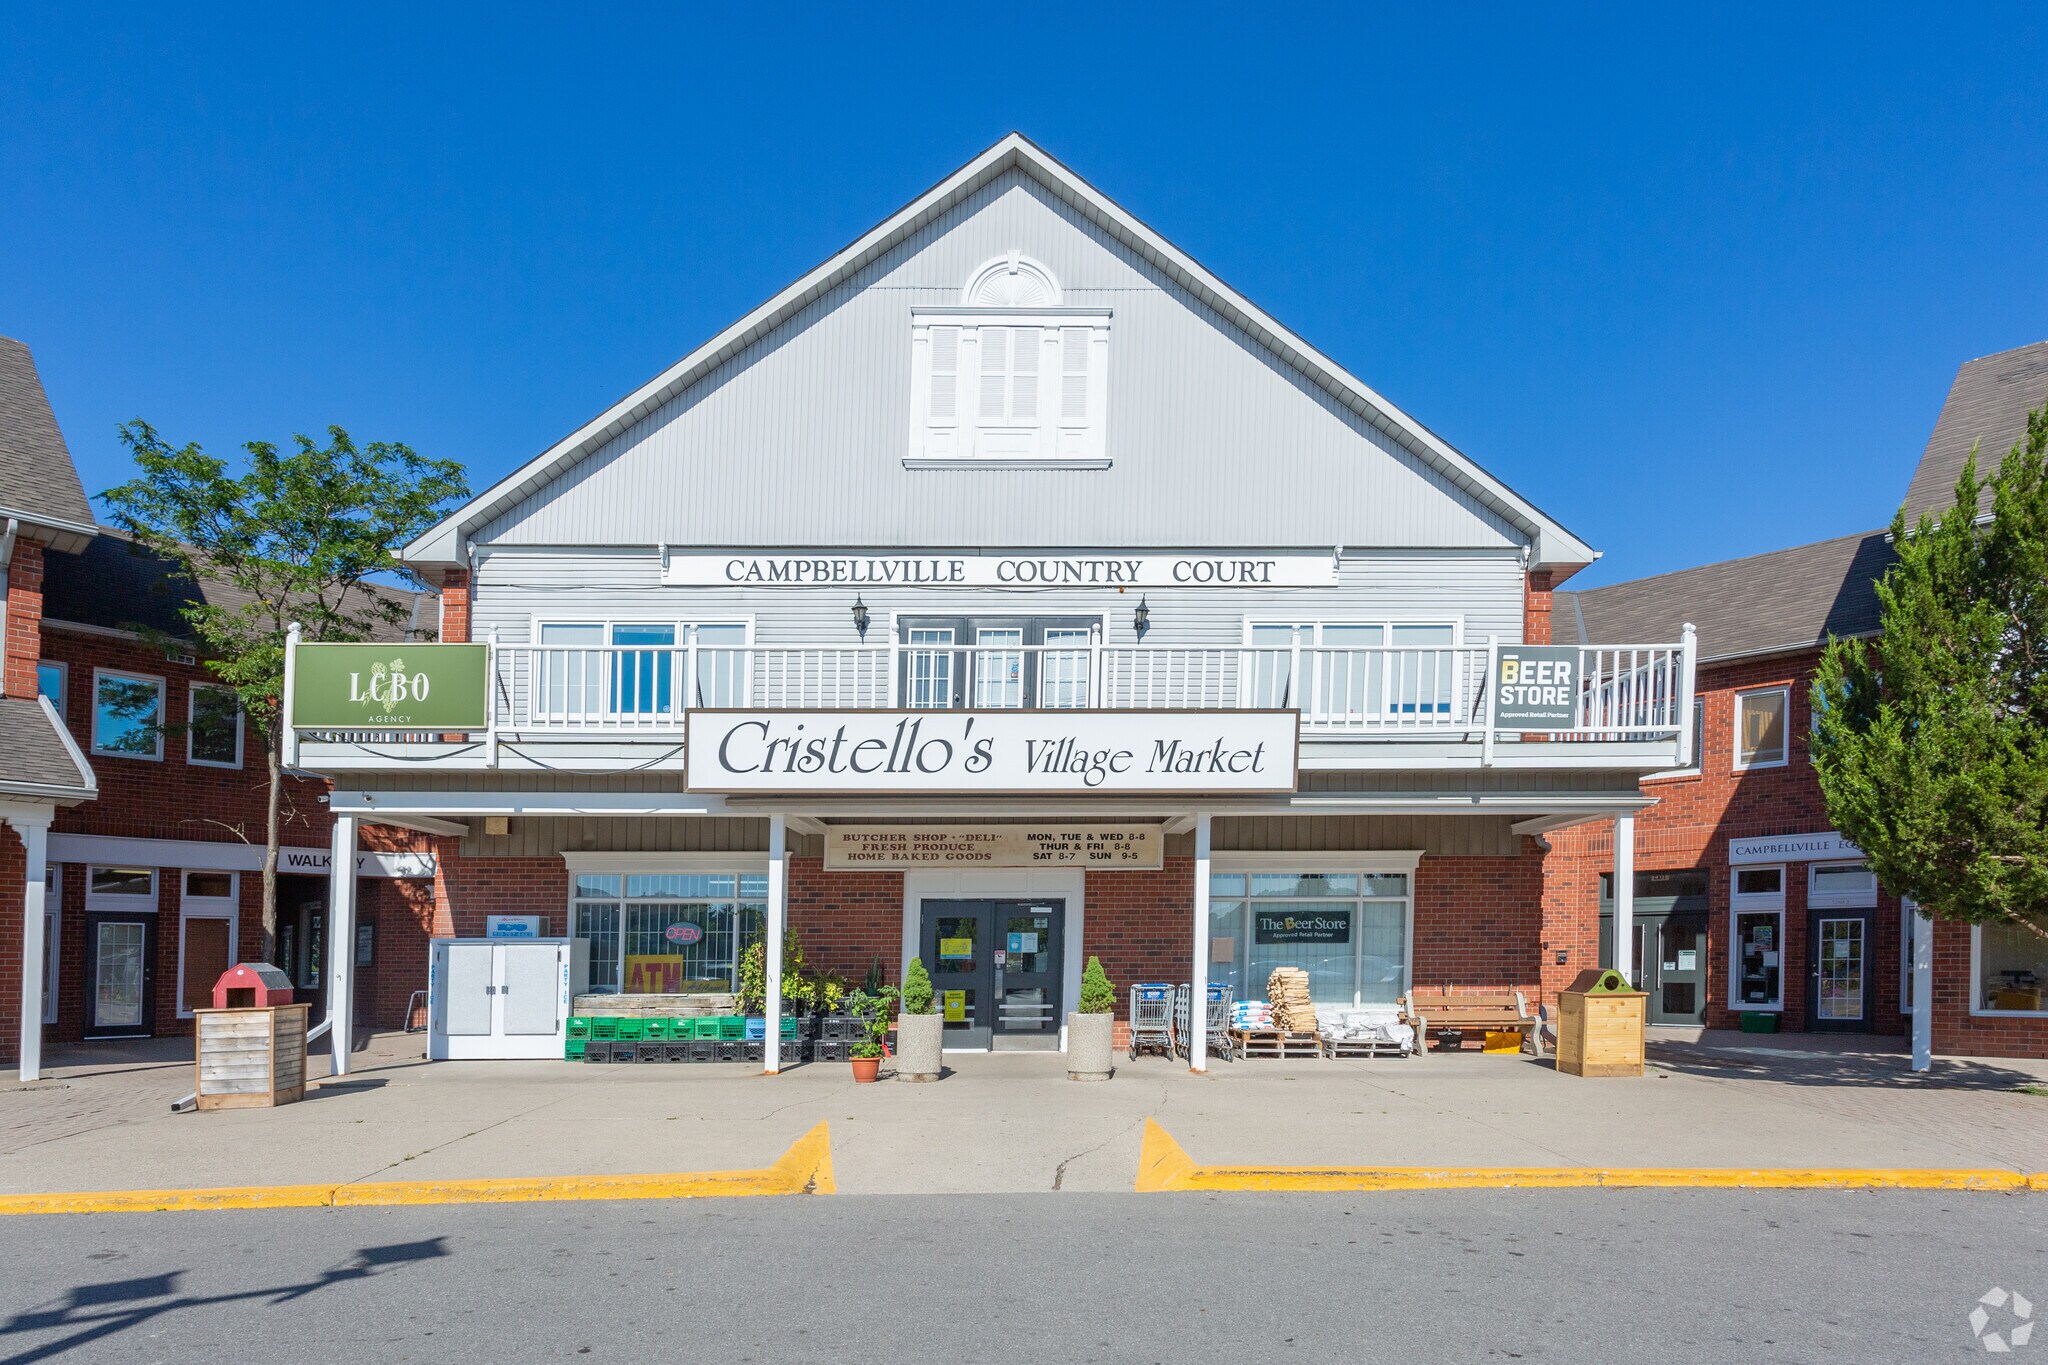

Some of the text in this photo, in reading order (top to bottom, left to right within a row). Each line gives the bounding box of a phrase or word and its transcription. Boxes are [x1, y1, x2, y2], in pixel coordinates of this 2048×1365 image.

[726, 560, 1275, 583] CAMPBELLVILLE COUNTRY COURT
[1501, 660, 1571, 685] BEER
[349, 672, 429, 701] LCBO
[1500, 686, 1570, 705] STORE
[368, 715, 411, 723] AGENCY
[719, 717, 1264, 786] Cristello's Village Market
[843, 834, 907, 842] BUTCHER
[913, 834, 947, 842] SHOP
[1027, 833, 1145, 842] MON, TUE & WED 8-8
[862, 843, 975, 851] FRESH PRODUCE
[1040, 843, 1131, 851] THUR & FRI 8-8
[1735, 841, 1830, 856] CAMPBELLVILLE
[288, 854, 365, 869] WALKY
[848, 853, 992, 861] HOME BAKED GOODS
[1033, 852, 1076, 860] SAT 8-7
[1089, 852, 1138, 860] SUN 9-5
[1260, 917, 1347, 930] The Beer Store
[665, 927, 701, 941] OPEN
[629, 963, 681, 993] ATM
